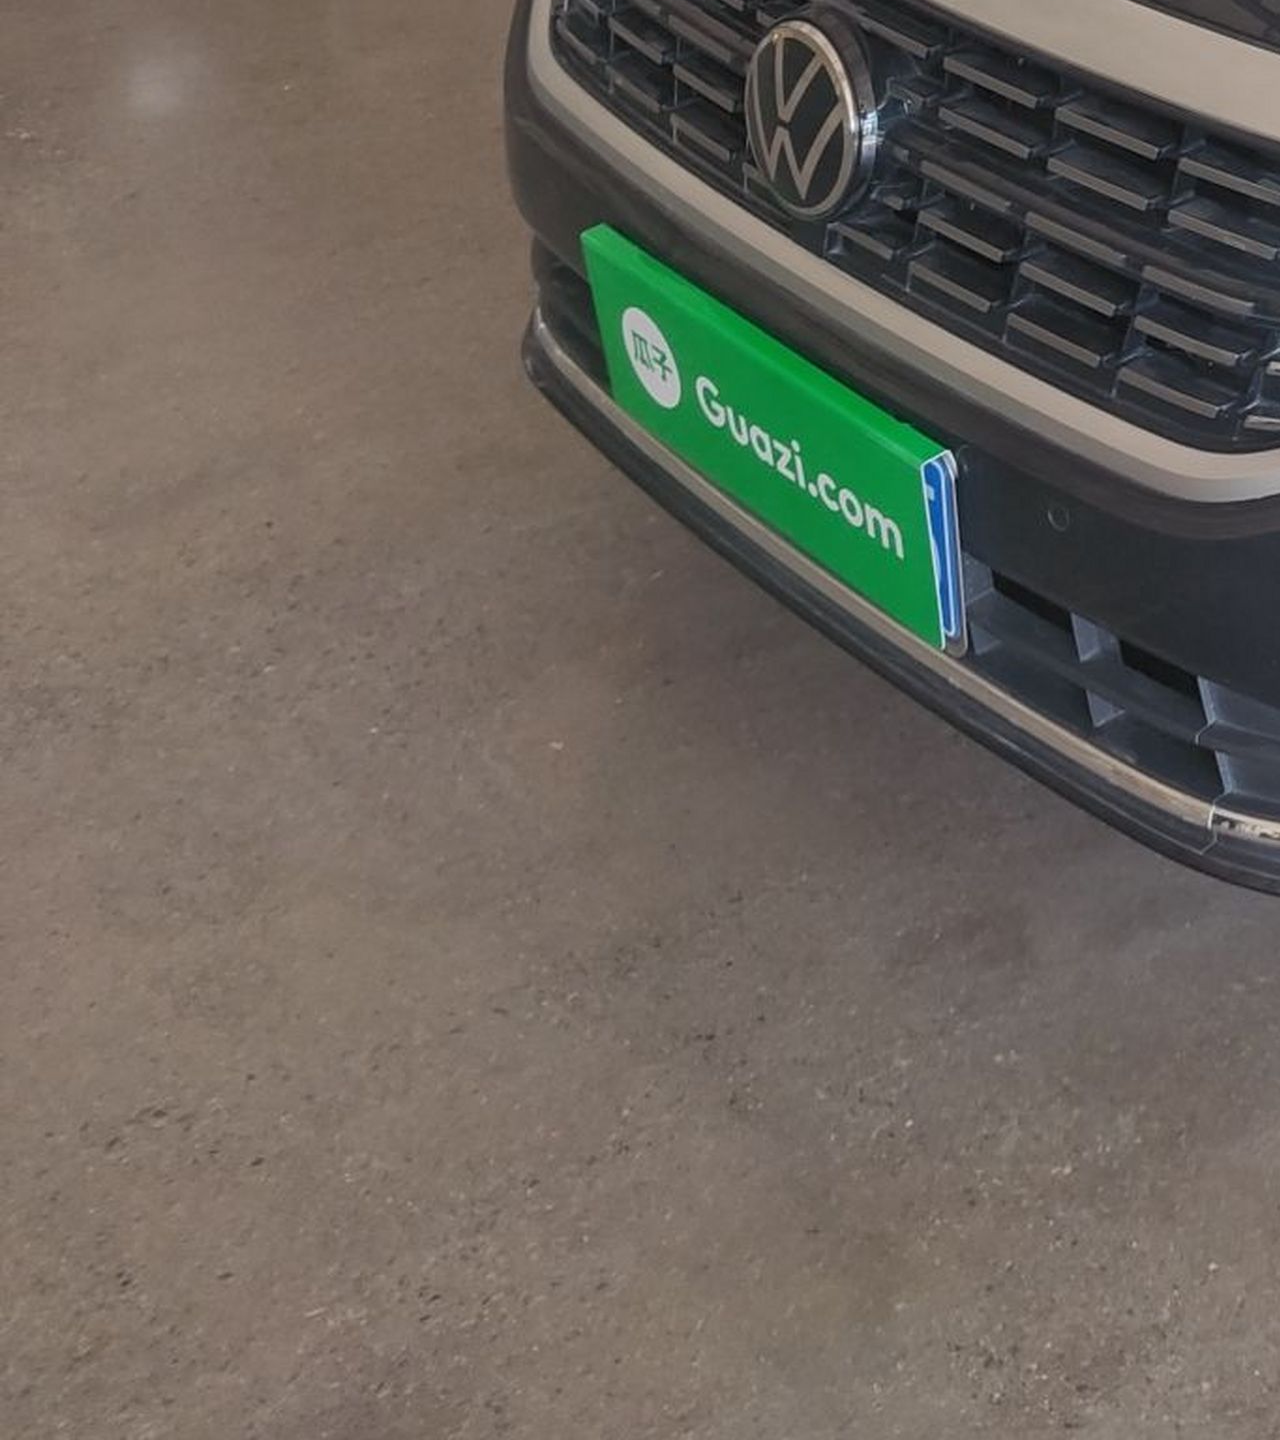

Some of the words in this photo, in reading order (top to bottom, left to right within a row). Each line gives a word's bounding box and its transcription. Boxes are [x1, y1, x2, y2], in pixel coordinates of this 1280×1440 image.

[747, 25, 854, 213] VW
[630, 328, 674, 382] 瓜子
[695, 375, 905, 559] Guazi.com
